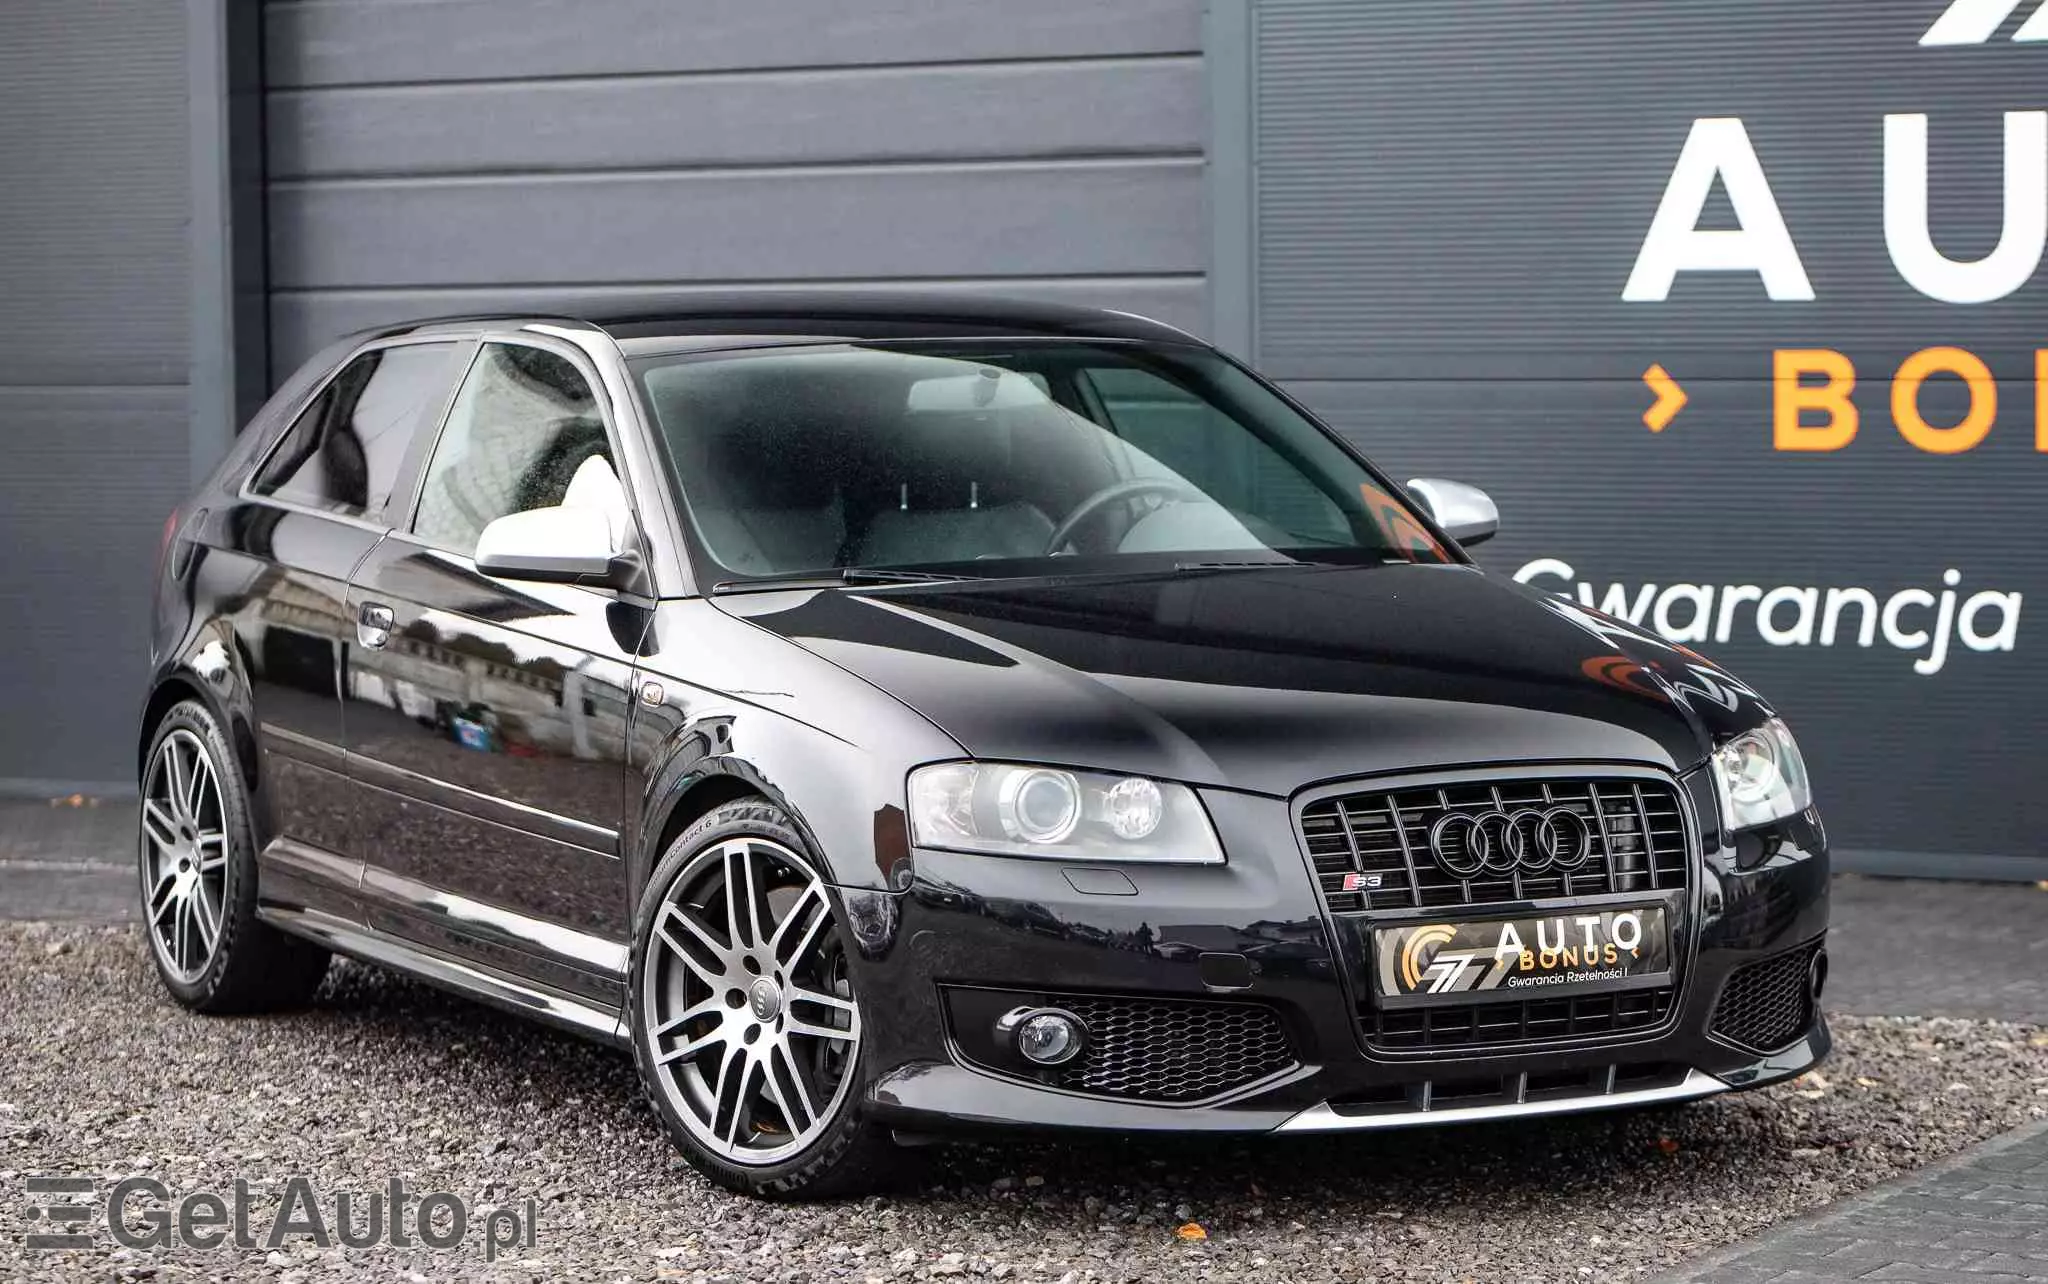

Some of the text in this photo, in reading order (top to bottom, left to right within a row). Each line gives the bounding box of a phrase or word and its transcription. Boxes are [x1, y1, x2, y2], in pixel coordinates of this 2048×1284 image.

[1621, 111, 2047, 304] AU
[1773, 346, 2048, 454] BO
[1352, 876, 1382, 887] S3
[1495, 912, 1642, 961] AUTO
[1519, 943, 1618, 971] BONUS
[1508, 972, 1565, 987] Gwarancja
[1566, 968, 1623, 983] Rzetelności
